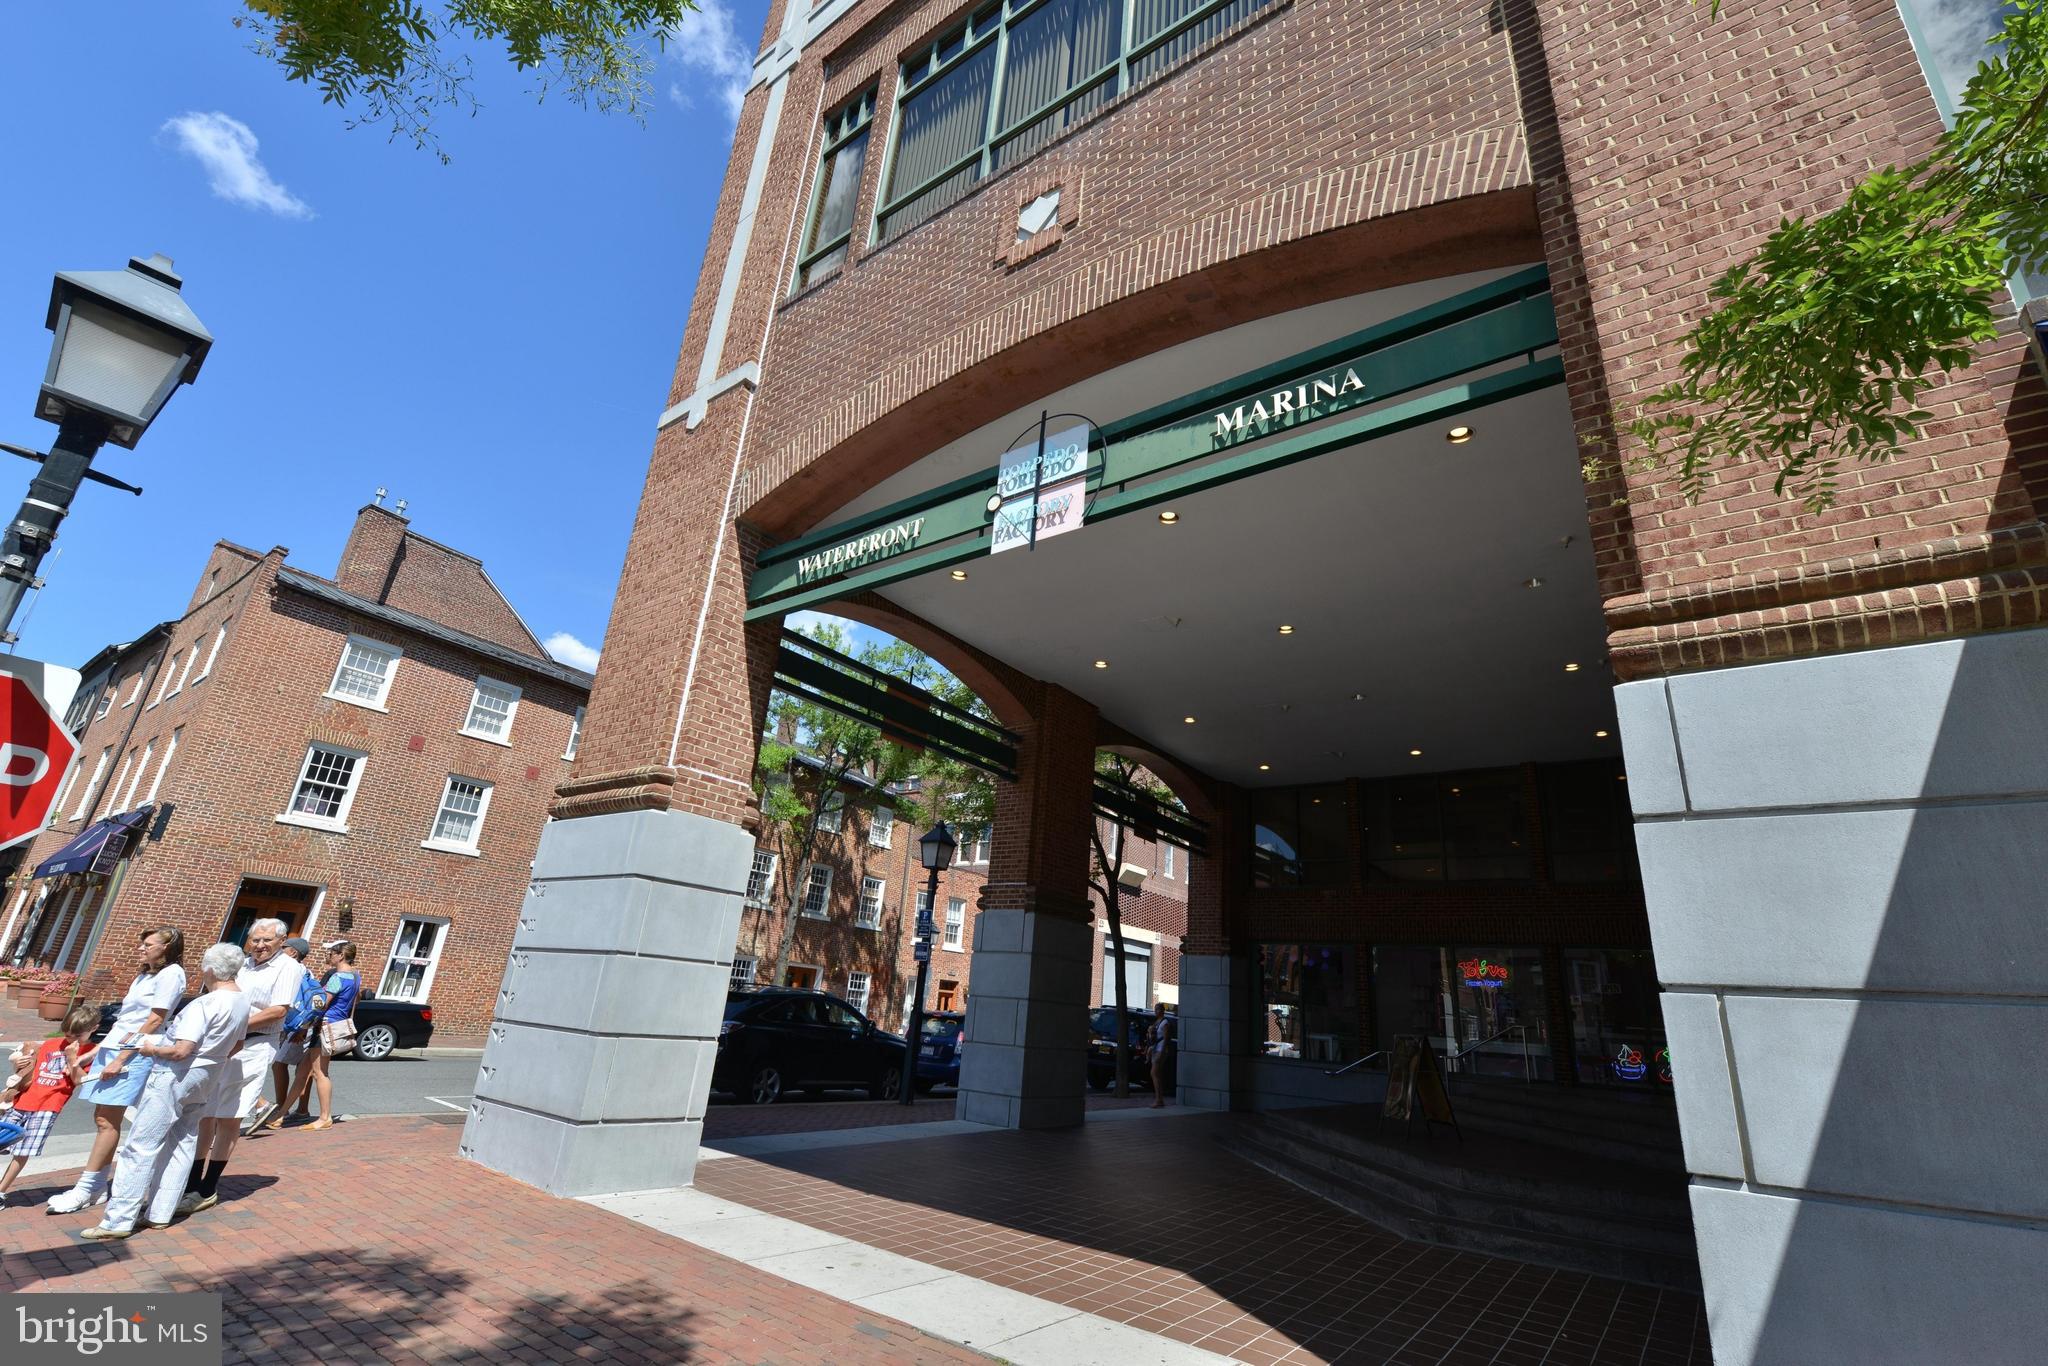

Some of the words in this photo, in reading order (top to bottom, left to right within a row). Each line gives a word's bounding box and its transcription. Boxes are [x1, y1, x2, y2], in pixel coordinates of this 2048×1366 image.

[1214, 367, 1366, 437] MARINA
[1000, 443, 1078, 480] TORPEDO
[998, 493, 1073, 529] FACTORY
[798, 517, 925, 576] WATERFRONT
